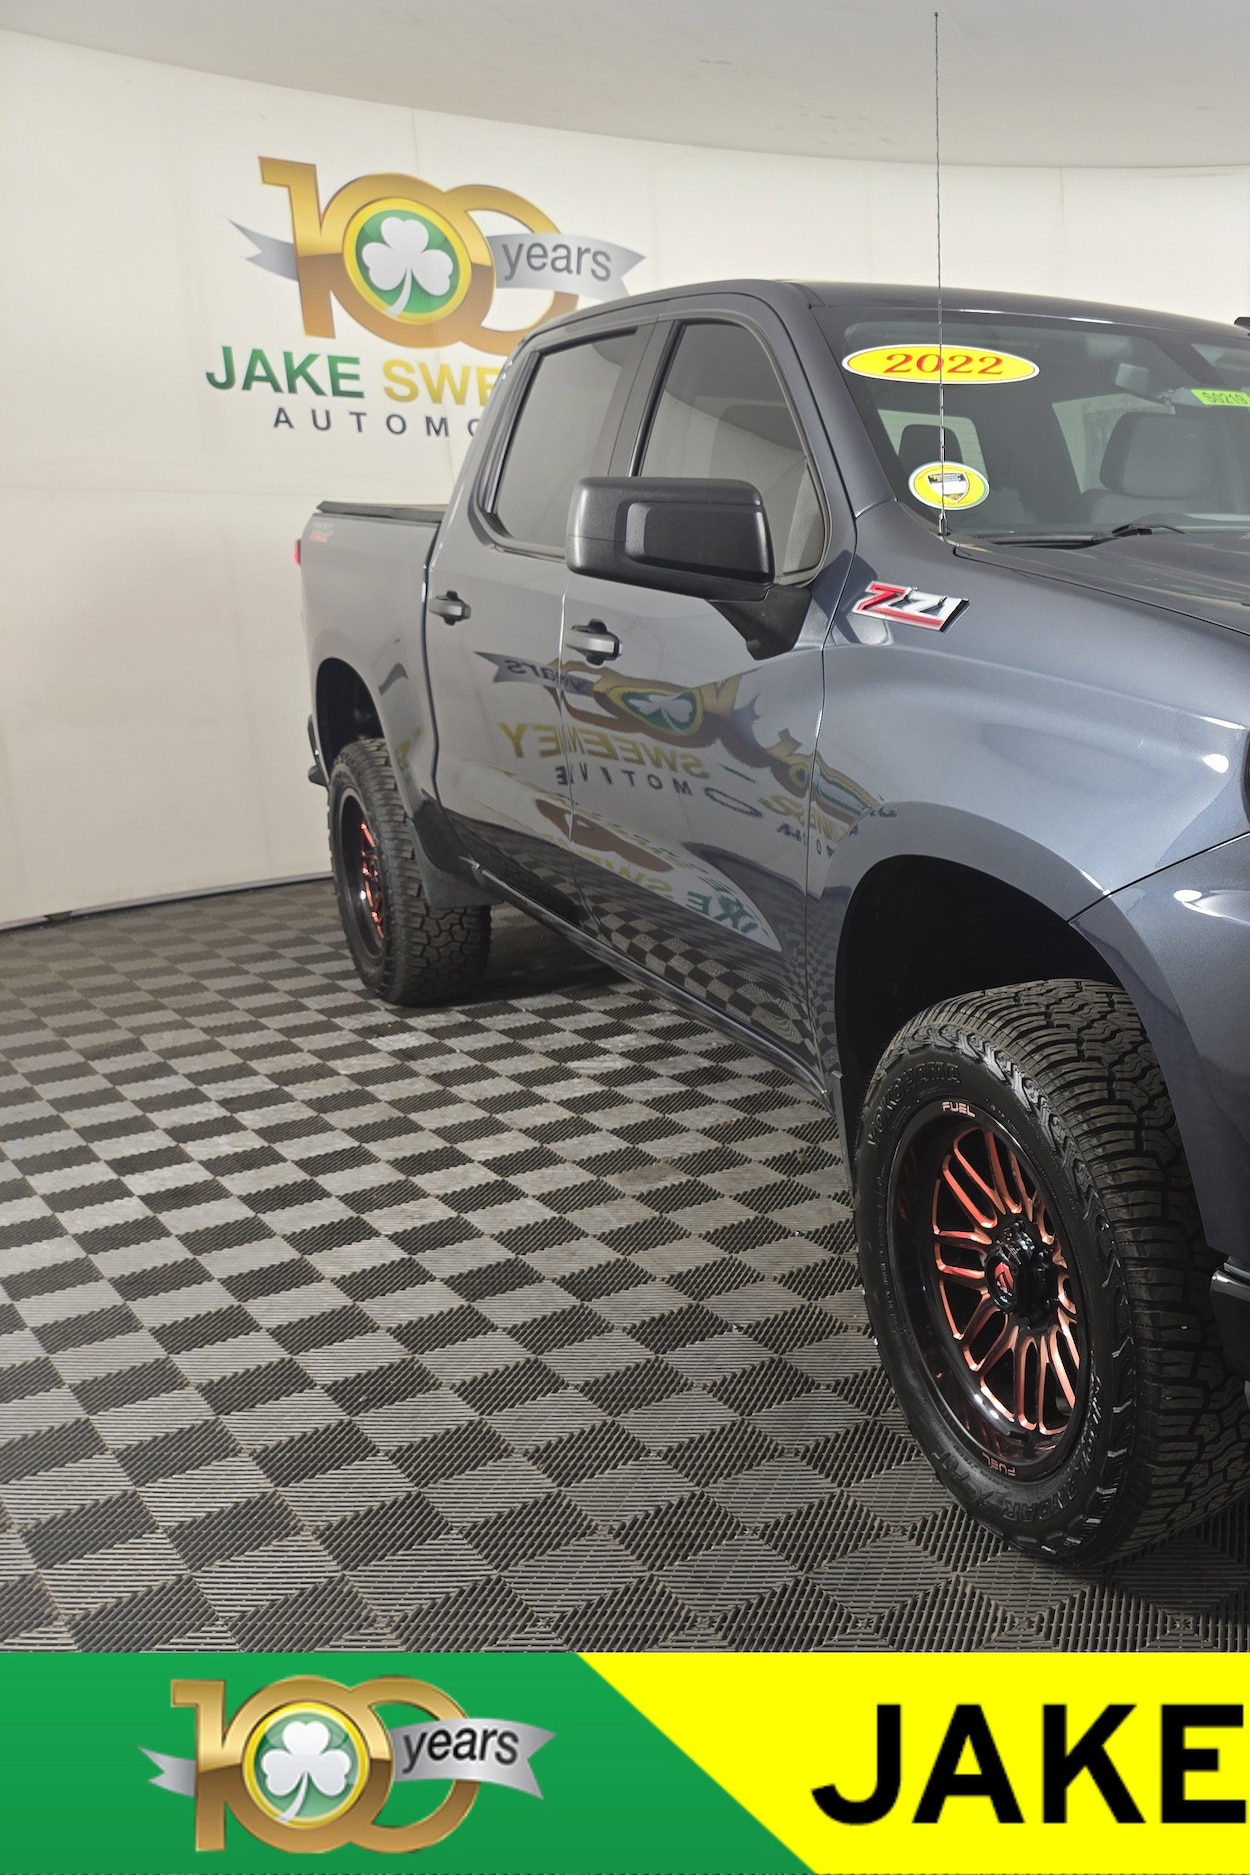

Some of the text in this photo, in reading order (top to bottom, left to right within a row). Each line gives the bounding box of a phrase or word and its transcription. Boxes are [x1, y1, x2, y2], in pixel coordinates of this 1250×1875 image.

[503, 242, 612, 282] years
[205, 345, 502, 407] JAKE SWE
[883, 353, 1004, 375] 2022
[273, 407, 482, 437] AUTOM
[941, 1100, 977, 1119] FUEL
[982, 1451, 1017, 1478] FUEL
